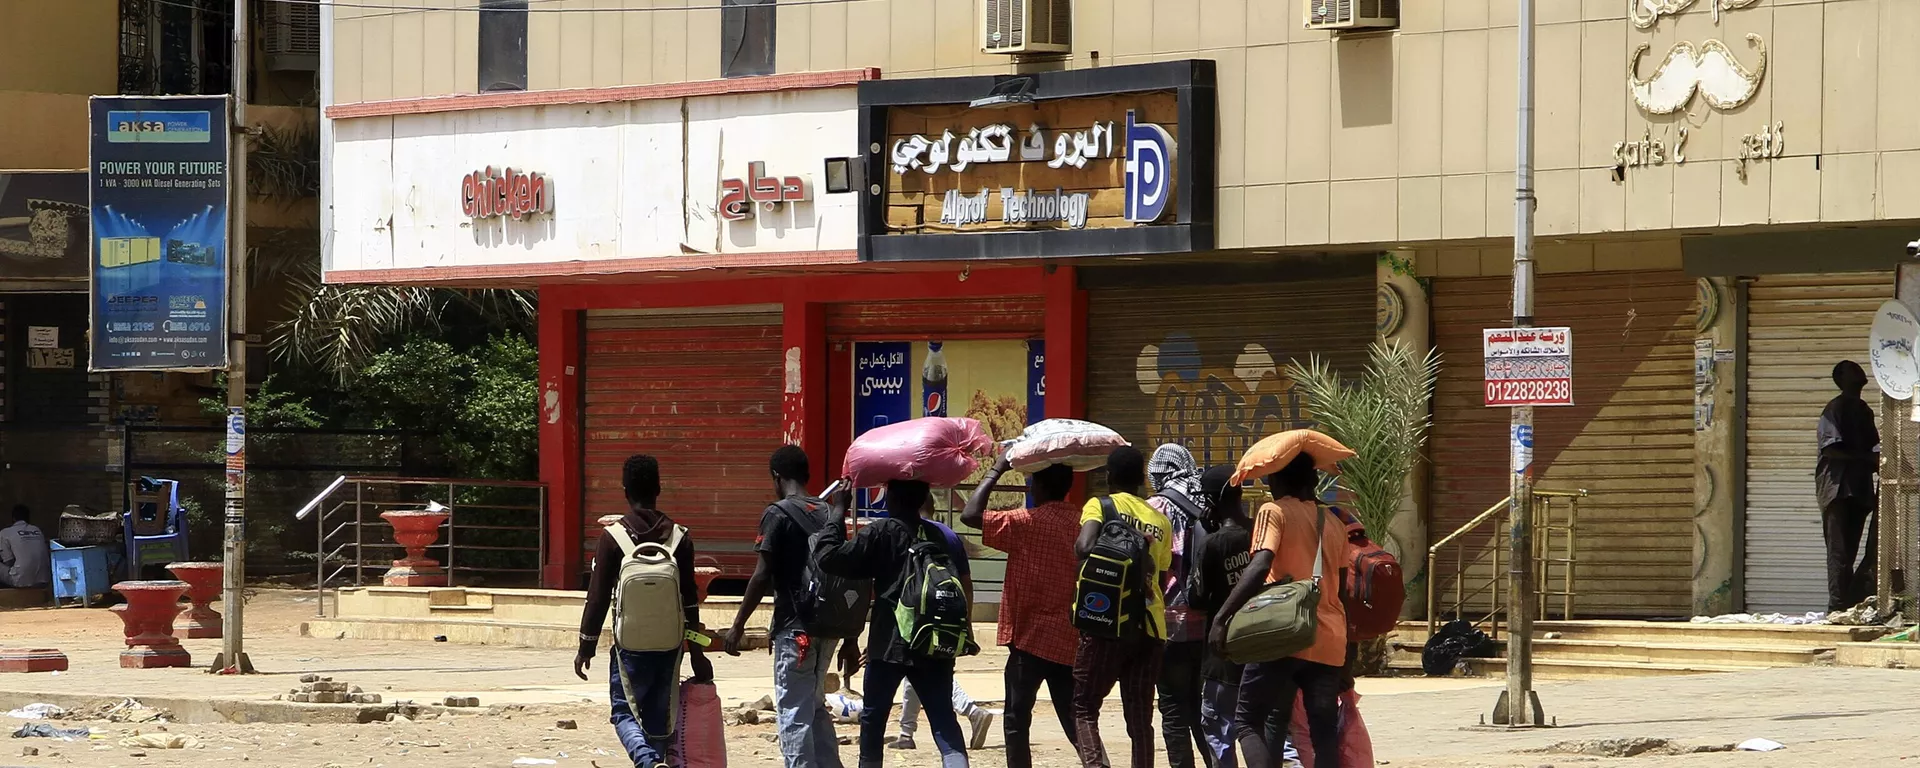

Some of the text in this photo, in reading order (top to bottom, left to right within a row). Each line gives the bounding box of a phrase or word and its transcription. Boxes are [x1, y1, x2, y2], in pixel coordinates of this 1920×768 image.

[119, 121, 165, 132] aksa
[891, 123, 1014, 175] تكنولوجي
[100, 161, 223, 175] POWER YOUR FUTURE
[105, 179, 117, 188] kVA
[123, 179, 140, 188] 3000
[141, 179, 153, 188] kVA
[154, 179, 173, 188] Diesel
[174, 179, 206, 189] Generating
[208, 179, 221, 188] Sets
[720, 161, 805, 221] دجاج
[941, 186, 1090, 229] Alprof Technology
[132, 322, 155, 331] 2195
[859, 358, 869, 370] مع
[1487, 380, 1569, 401] 0122828238
[1224, 551, 1251, 571] GOOD
